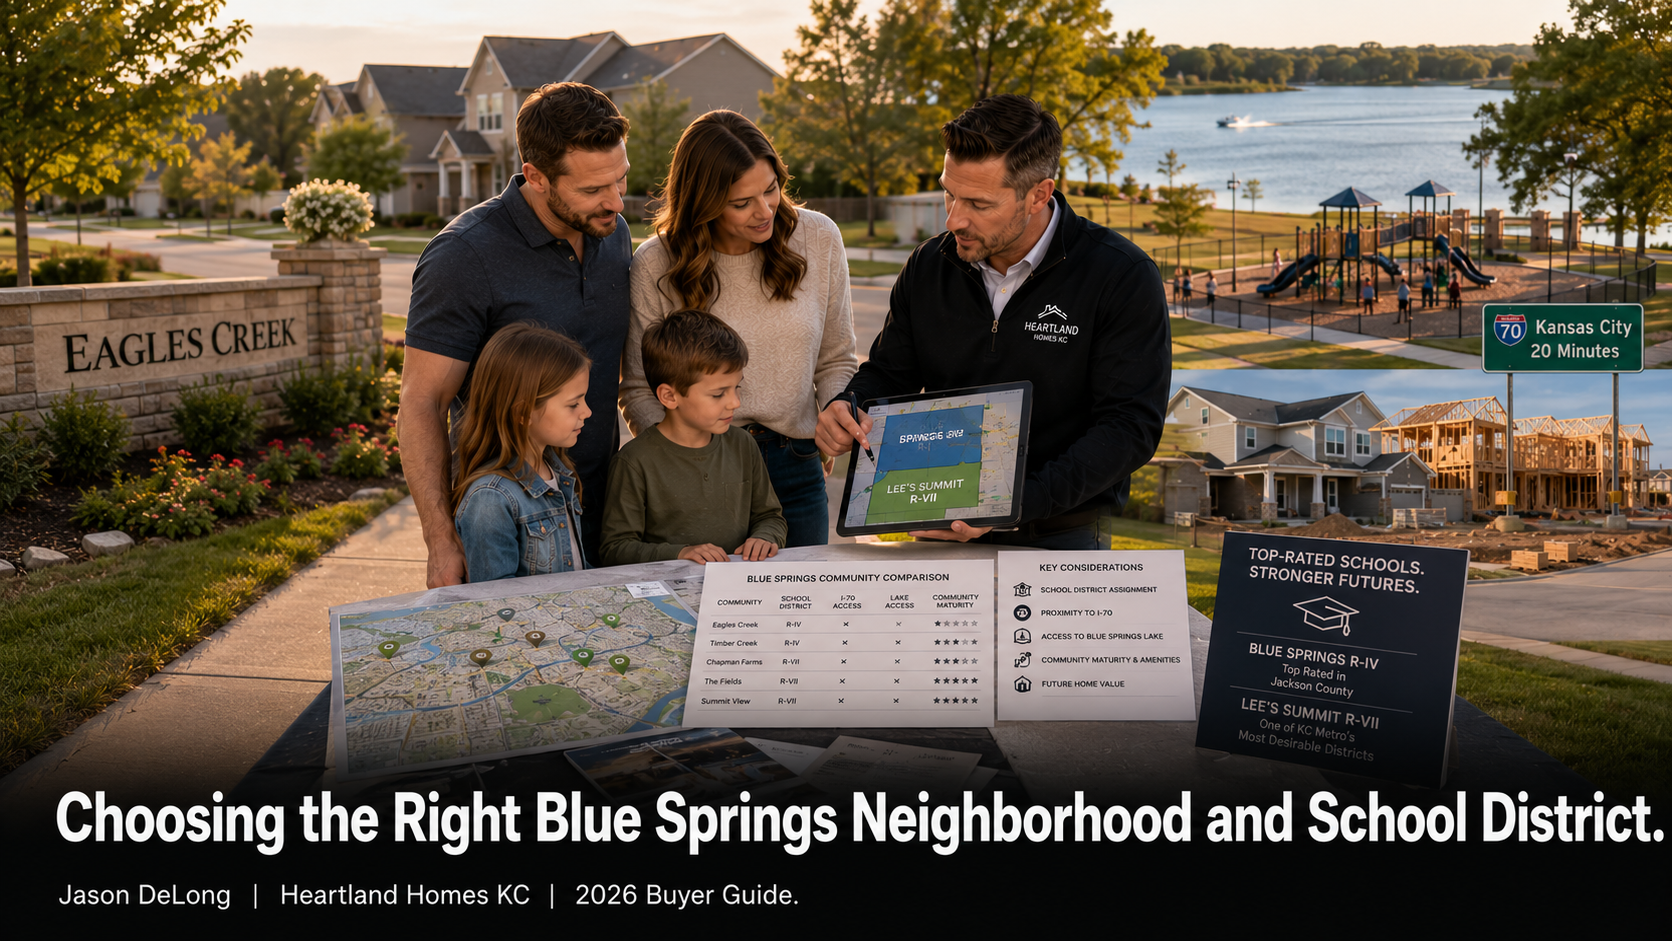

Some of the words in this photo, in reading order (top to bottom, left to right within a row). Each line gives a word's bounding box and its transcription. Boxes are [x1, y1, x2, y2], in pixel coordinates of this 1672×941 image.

[1025, 322, 1079, 335] HEARTLAND
[1501, 324, 1521, 339] 70
[1536, 319, 1593, 334] Kansas
[1600, 319, 1632, 338] City
[63, 327, 203, 374] EAGLES
[211, 317, 296, 355] CREEK
[1531, 344, 1551, 358] 20
[1558, 344, 1619, 358] Minutes
[887, 483, 916, 494] LEE'S
[919, 479, 964, 491] SUMMIT
[910, 493, 937, 504] R-VII
[1040, 564, 1057, 572] KEY
[1060, 563, 1143, 572] CONSIDERATIONS
[1248, 547, 1335, 568] TOP-RATED
[1340, 556, 1425, 575] SCHOOLS.
[747, 574, 771, 583] BLUE
[774, 574, 816, 582] SPRINGS
[819, 574, 880, 582] COMMUNITY
[883, 574, 949, 582] COMPARISON
[1249, 565, 1334, 586] STRONGER
[1338, 573, 1420, 594] FUTURES.
[781, 596, 811, 604] SCHOOL
[833, 602, 862, 610] ACCESS
[713, 621, 735, 630] Eagles
[706, 658, 740, 667] Chapman
[741, 658, 762, 666] Farms
[1249, 642, 1283, 658] BLUE
[1286, 647, 1346, 665] SPRINGS
[1350, 655, 1379, 670] R-IV
[1282, 663, 1300, 677] Top
[1303, 666, 1334, 680] Rated
[1336, 670, 1346, 681] in
[1270, 677, 1313, 692] Jackson
[1315, 682, 1353, 699] County
[701, 697, 730, 705] Summit
[1241, 697, 1279, 714] LEE'S
[1283, 704, 1342, 724] SUMMIT
[1345, 713, 1380, 730] R-VII
[1260, 718, 1281, 731] One
[1283, 722, 1295, 733] of
[1297, 723, 1312, 735] KC
[1315, 726, 1356, 743] Metro's
[1238, 729, 1265, 744] Most
[1269, 734, 1321, 752] Desirable
[1325, 743, 1374, 762] Districts
